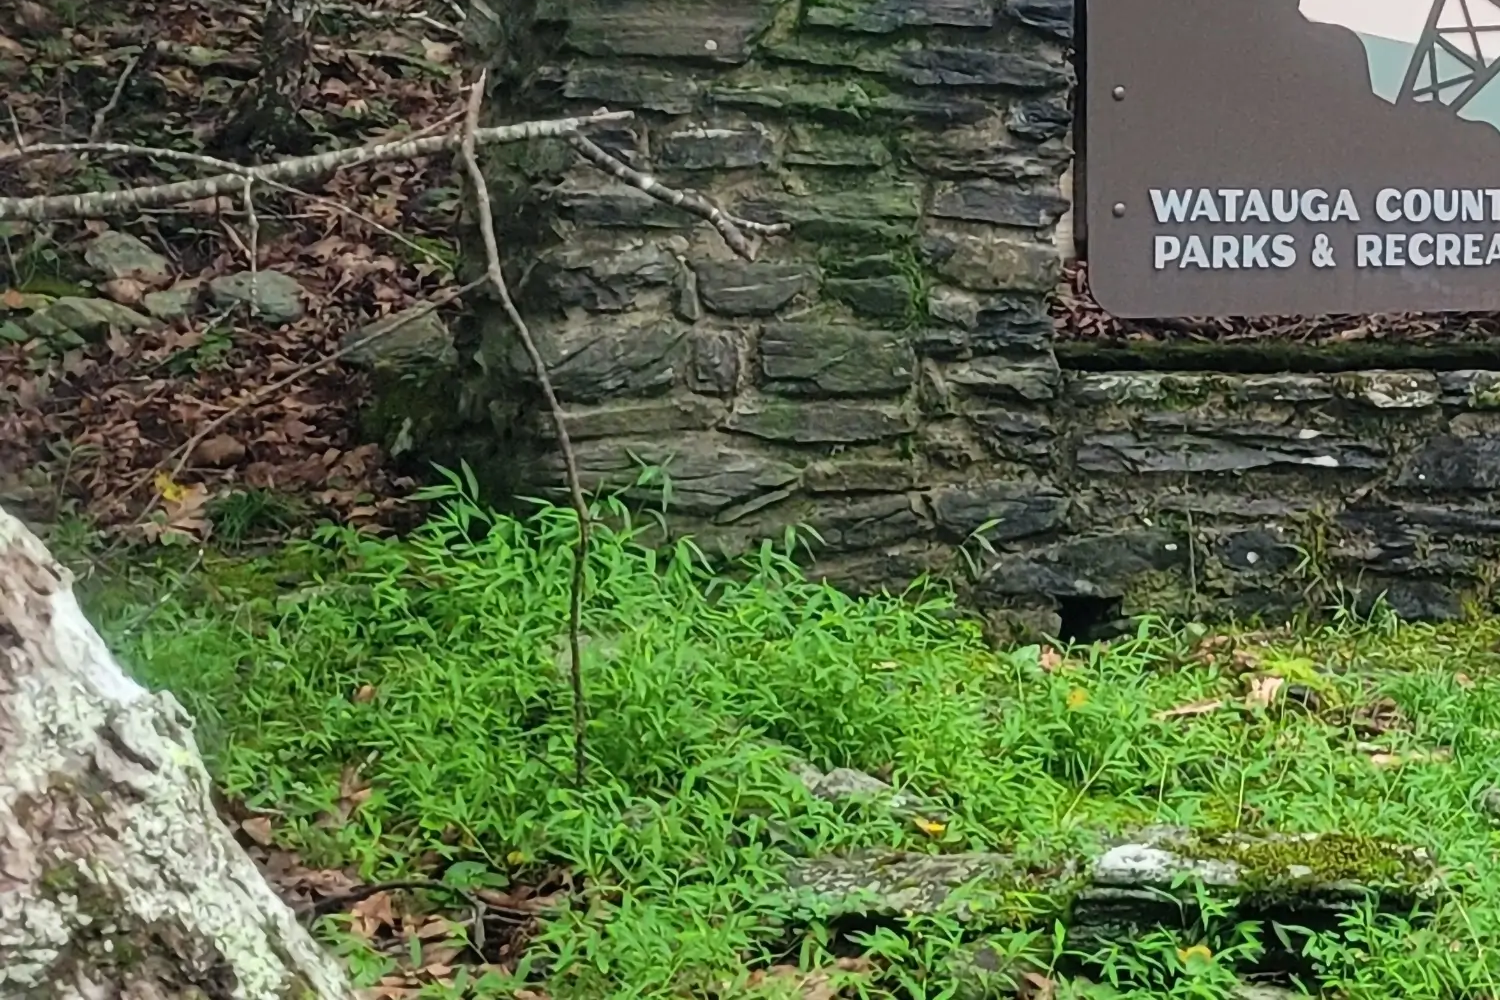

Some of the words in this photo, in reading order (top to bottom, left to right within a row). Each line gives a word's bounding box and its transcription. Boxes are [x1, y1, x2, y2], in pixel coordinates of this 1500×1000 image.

[1150, 188, 1360, 223] WATAUGA
[1153, 234, 1296, 269] PARKS
[1311, 233, 1335, 267] &
